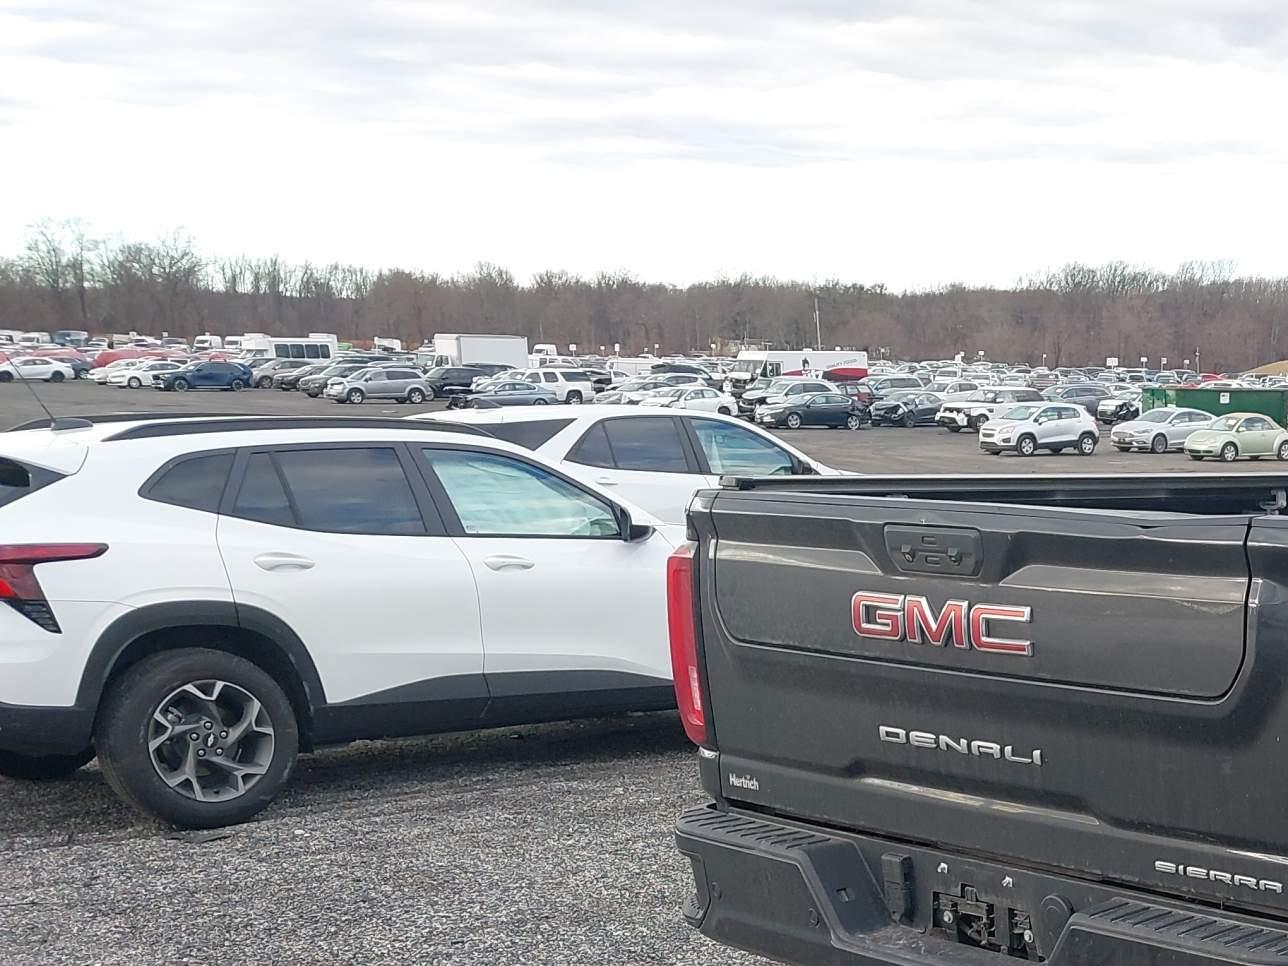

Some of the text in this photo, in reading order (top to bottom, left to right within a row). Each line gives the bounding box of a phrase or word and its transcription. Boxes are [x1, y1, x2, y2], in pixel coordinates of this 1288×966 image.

[851, 591, 1032, 656] GMC
[879, 725, 1042, 766] DENALI
[1154, 860, 1283, 893] SIERRA
